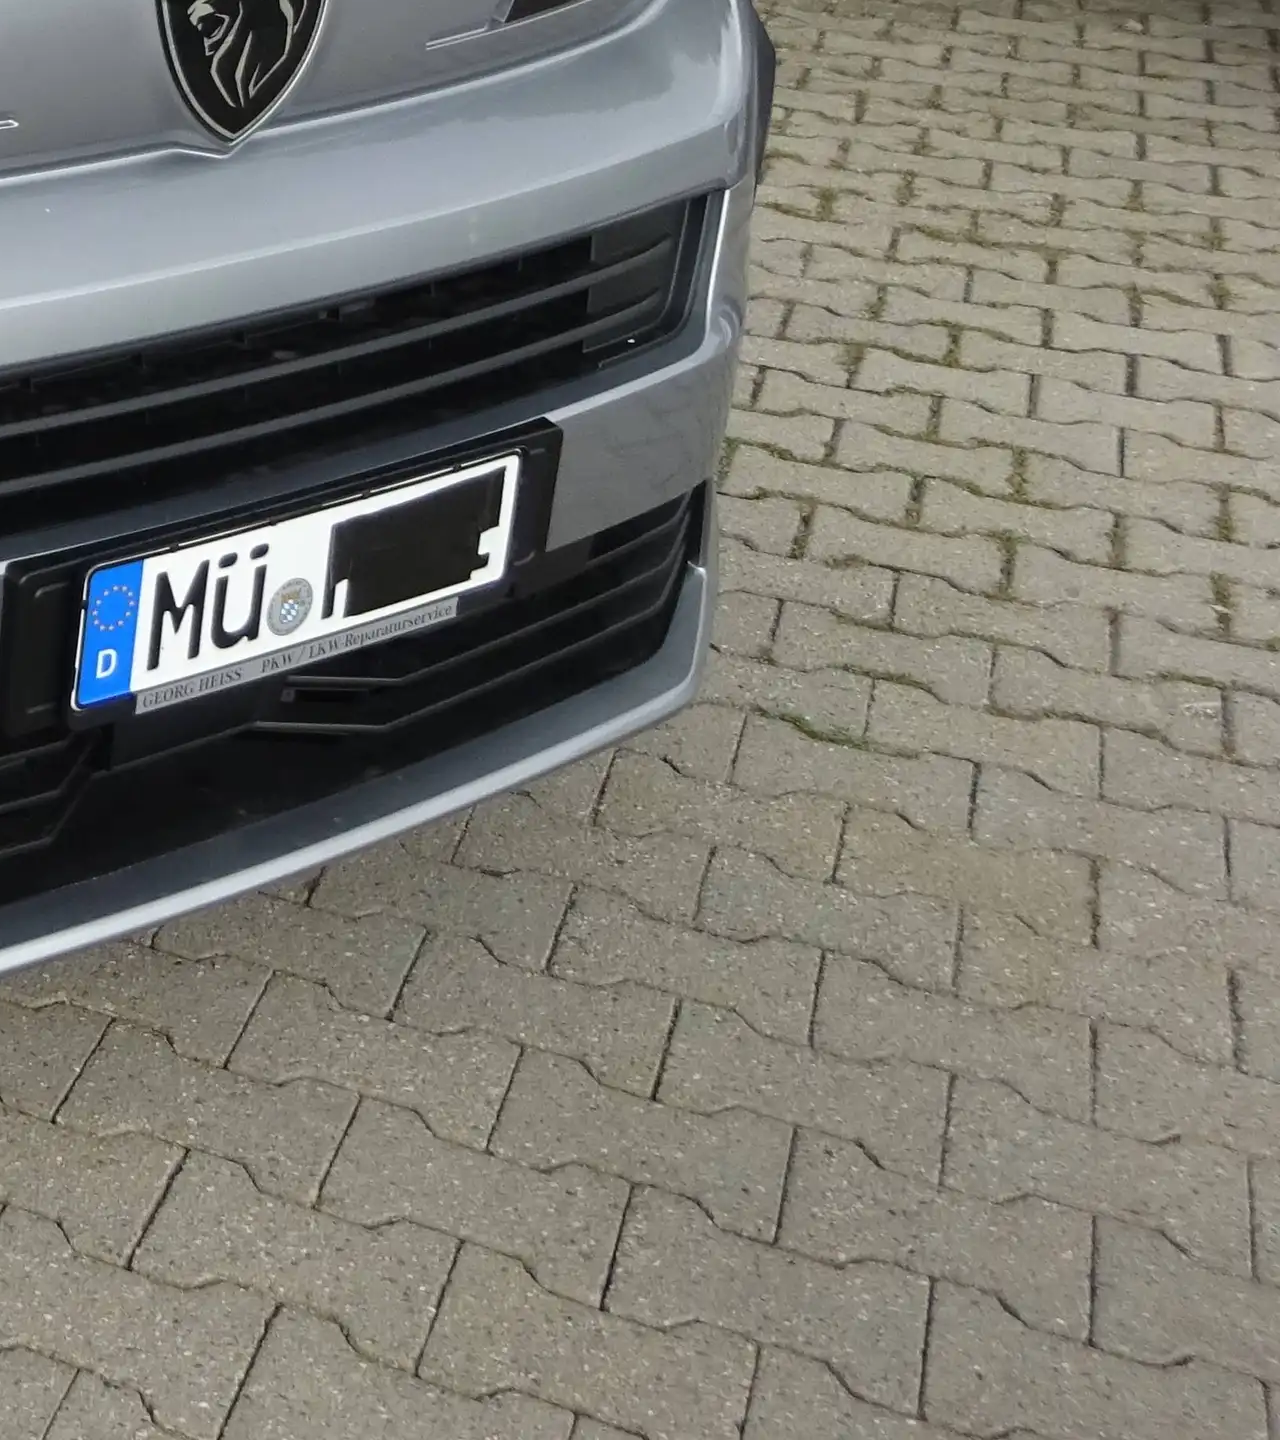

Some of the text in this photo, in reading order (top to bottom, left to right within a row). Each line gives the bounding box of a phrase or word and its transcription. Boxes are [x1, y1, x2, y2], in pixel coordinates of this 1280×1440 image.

[147, 543, 269, 671] MÜ
[95, 648, 117, 679] D
[142, 682, 194, 708] GEORG
[198, 668, 244, 693] HEISS
[260, 651, 294, 674] PKW
